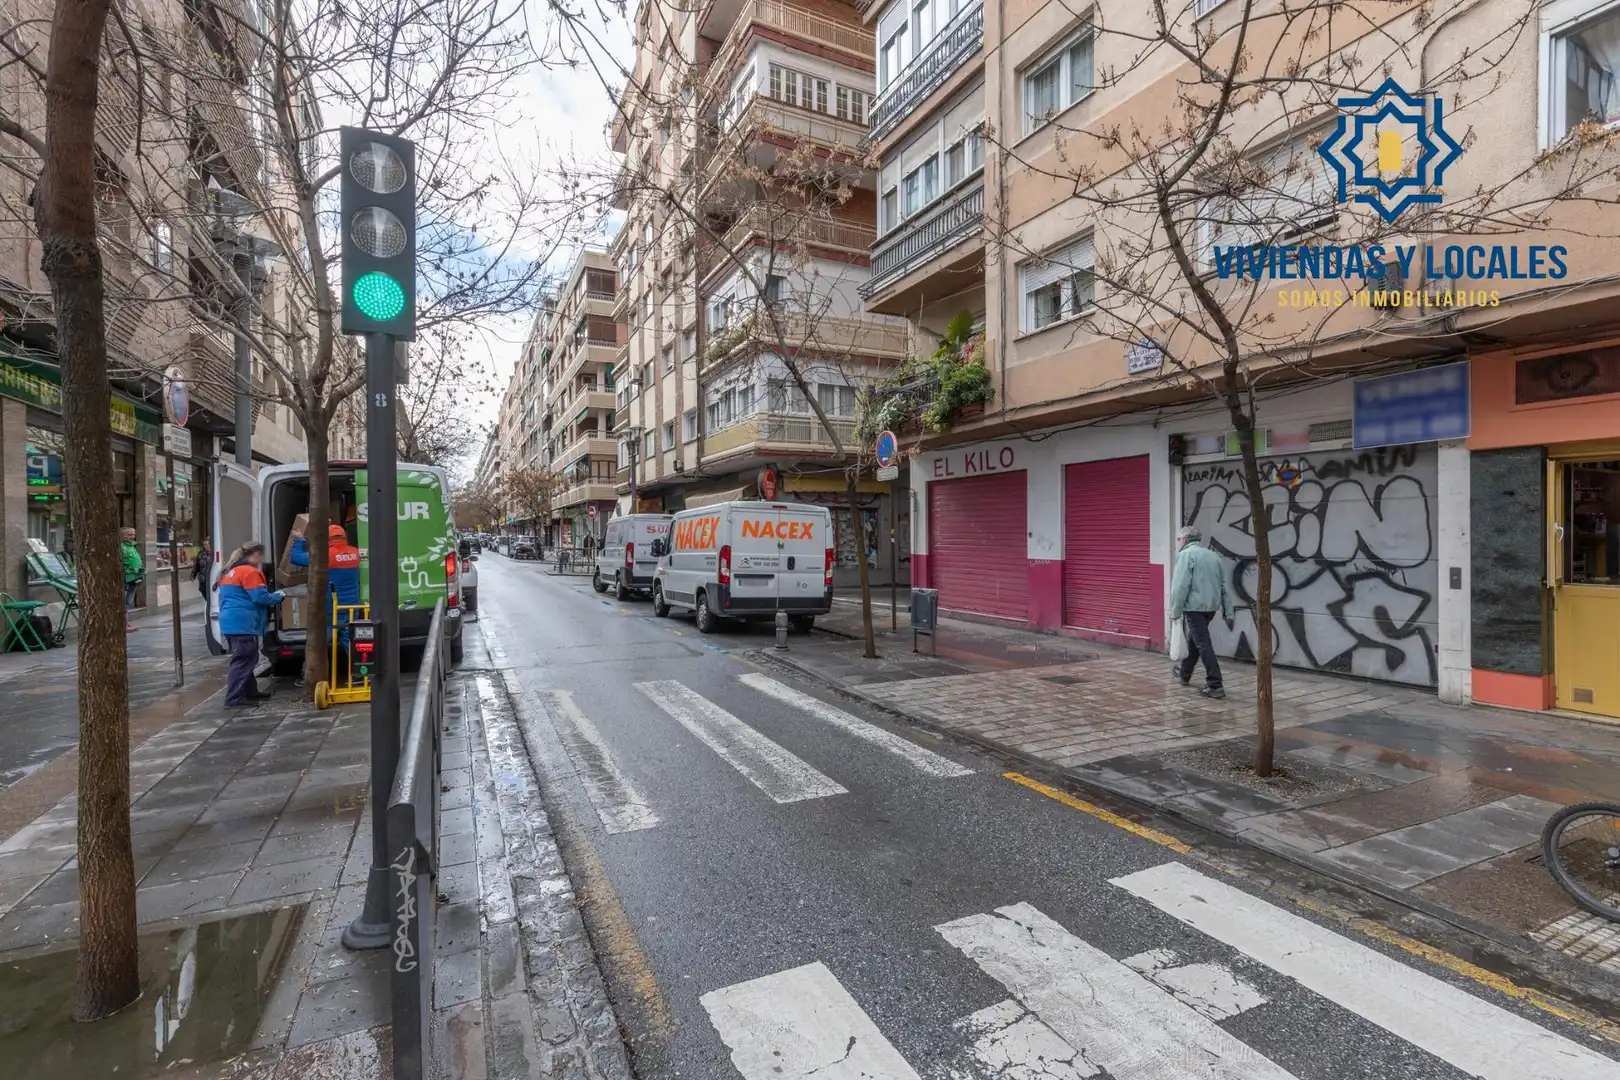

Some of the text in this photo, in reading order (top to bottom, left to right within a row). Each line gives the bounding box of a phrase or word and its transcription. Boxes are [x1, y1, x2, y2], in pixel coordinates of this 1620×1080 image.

[934, 446, 1014, 478] EL KILO
[357, 501, 430, 522] SUR
[675, 516, 721, 550] NACEX
[741, 519, 815, 540] NACEX
